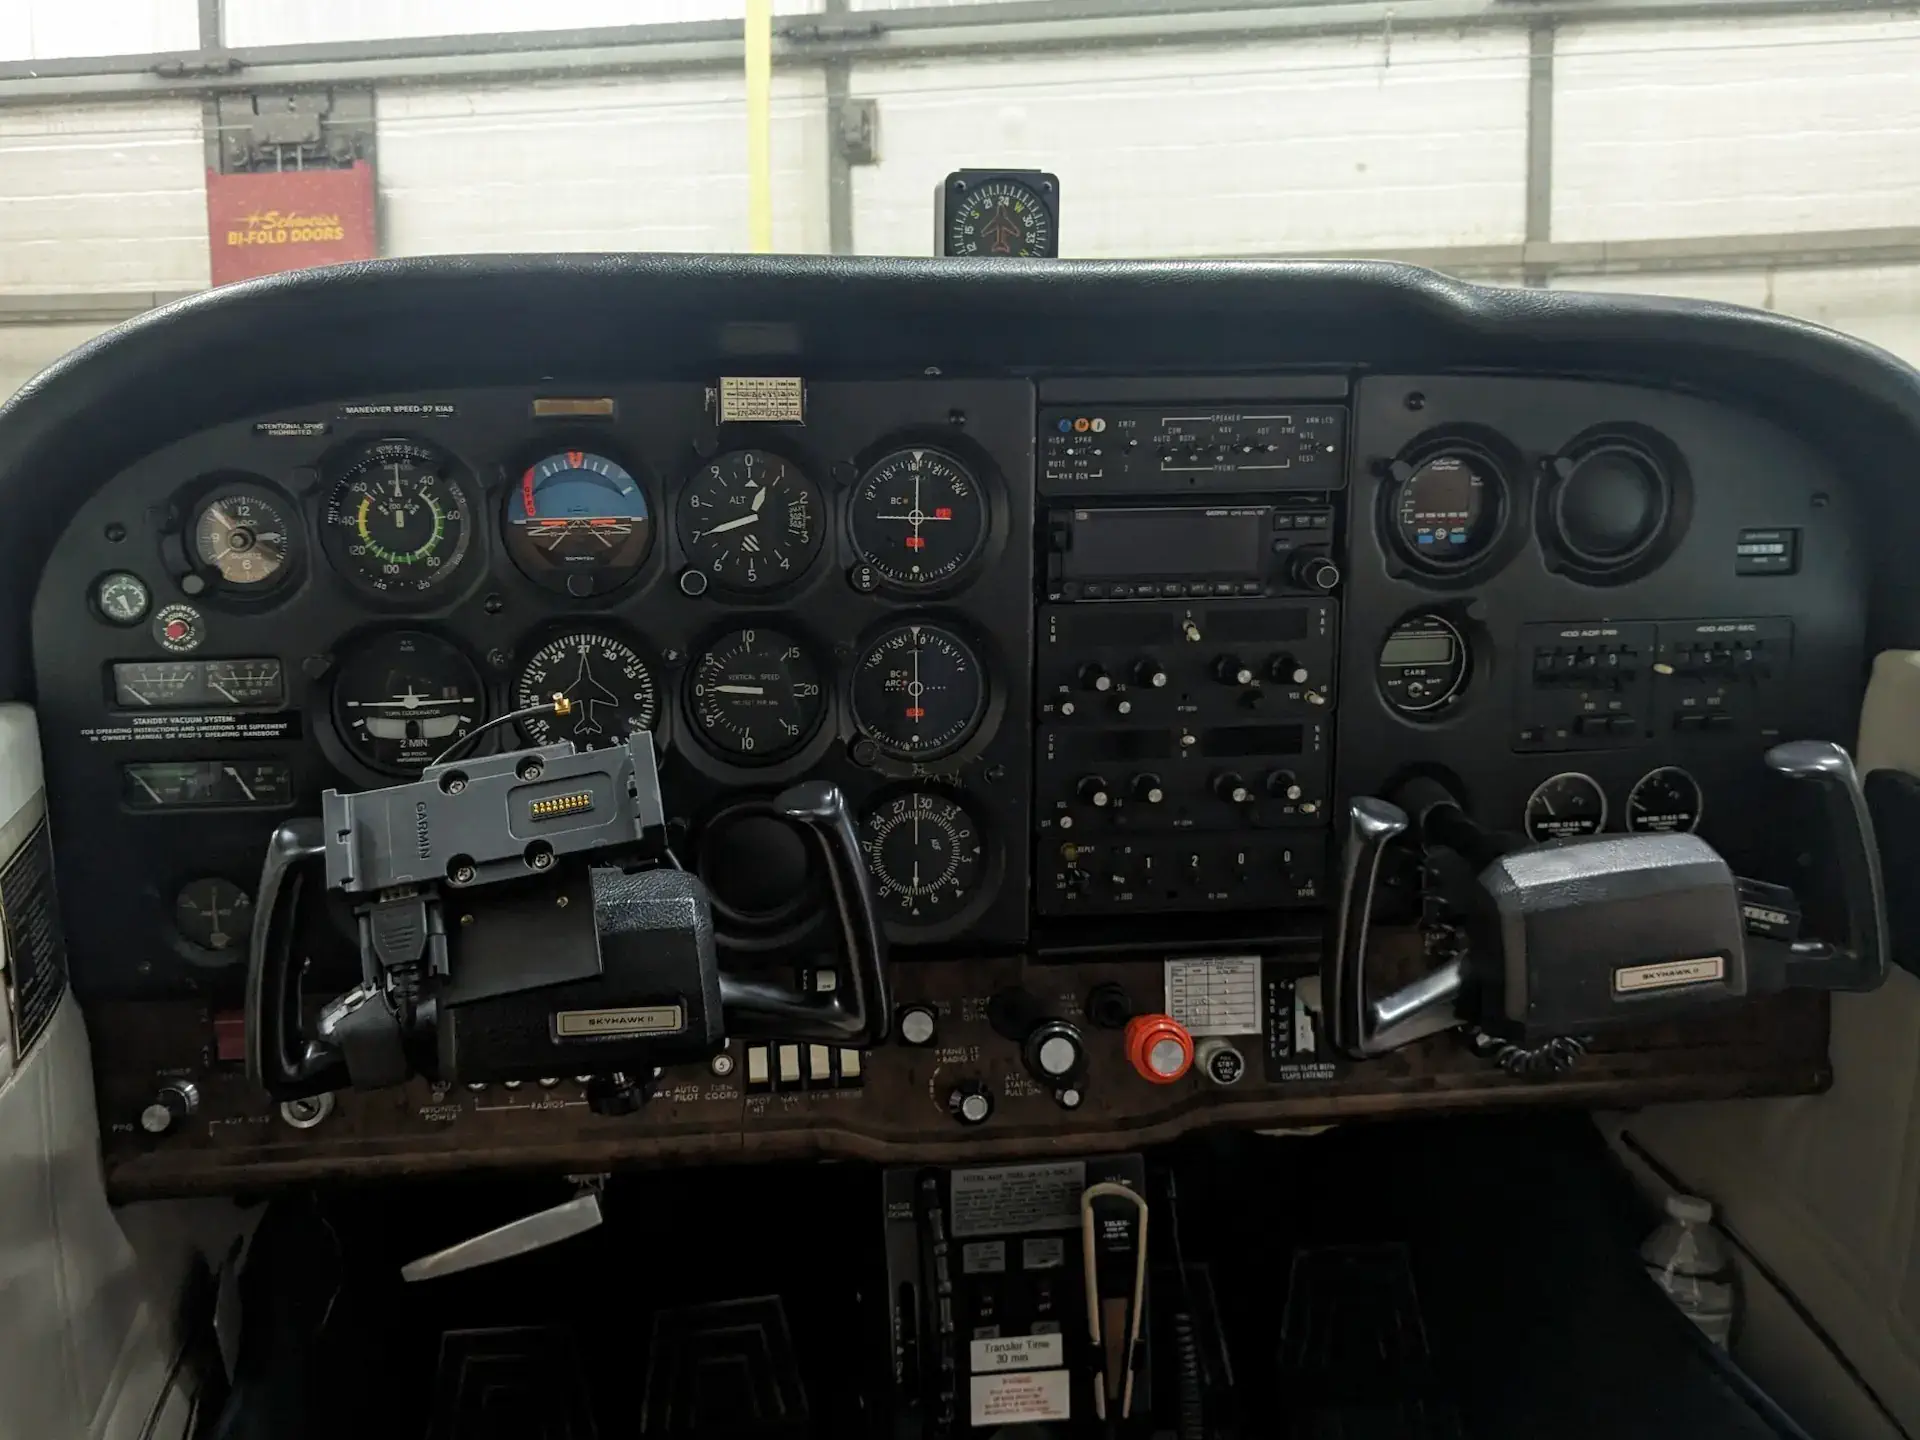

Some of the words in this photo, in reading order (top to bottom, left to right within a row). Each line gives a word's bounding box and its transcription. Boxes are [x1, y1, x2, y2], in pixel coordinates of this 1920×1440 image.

[227, 230, 287, 246] BI-FOLD
[291, 227, 344, 242] DOORS
[435, 405, 454, 413] KIAS
[745, 454, 753, 466] 0
[710, 465, 719, 478] 9
[419, 476, 434, 485] 40
[691, 495, 700, 507] 8
[729, 496, 746, 504] ALT
[800, 491, 808, 504] 2
[237, 505, 251, 516] 12
[447, 511, 460, 520] 60
[692, 531, 701, 543] 7
[800, 531, 809, 543] 3
[242, 559, 252, 570] 6
[427, 557, 440, 567] 80
[713, 558, 722, 571] 6
[780, 558, 790, 570] 4
[383, 565, 400, 574] 100
[748, 569, 757, 582] 5
[742, 630, 755, 642] 10
[163, 640, 198, 652] WARNING
[551, 651, 565, 664] 24
[602, 649, 617, 661] 30
[788, 647, 800, 658] 15
[705, 653, 714, 665] 5
[534, 670, 547, 683] 21
[623, 665, 636, 680] 33
[695, 684, 704, 696] 0
[803, 684, 818, 695] 20
[132, 717, 168, 725] STANDBY
[170, 716, 203, 724] VACUUM
[706, 715, 715, 727] 5
[459, 729, 466, 737] R
[788, 725, 799, 735] 15
[361, 733, 369, 741] L
[400, 740, 406, 748] 2
[741, 737, 754, 750] 10
[892, 800, 905, 814] 27
[918, 798, 932, 809] 30
[941, 805, 957, 820] 33
[870, 814, 885, 830] 24
[416, 802, 431, 860] GARMIN
[1191, 855, 1199, 867] 2
[1238, 853, 1245, 864] 0
[1284, 850, 1291, 862] 0
[1642, 969, 1690, 980] SKYHAWK
[589, 1017, 644, 1025] SKYHAWK
[675, 1086, 699, 1094] AUTO
[1005, 1080, 1033, 1088] STATIC
[675, 1093, 700, 1101] PILOT
[1026, 1340, 1050, 1349] Time
